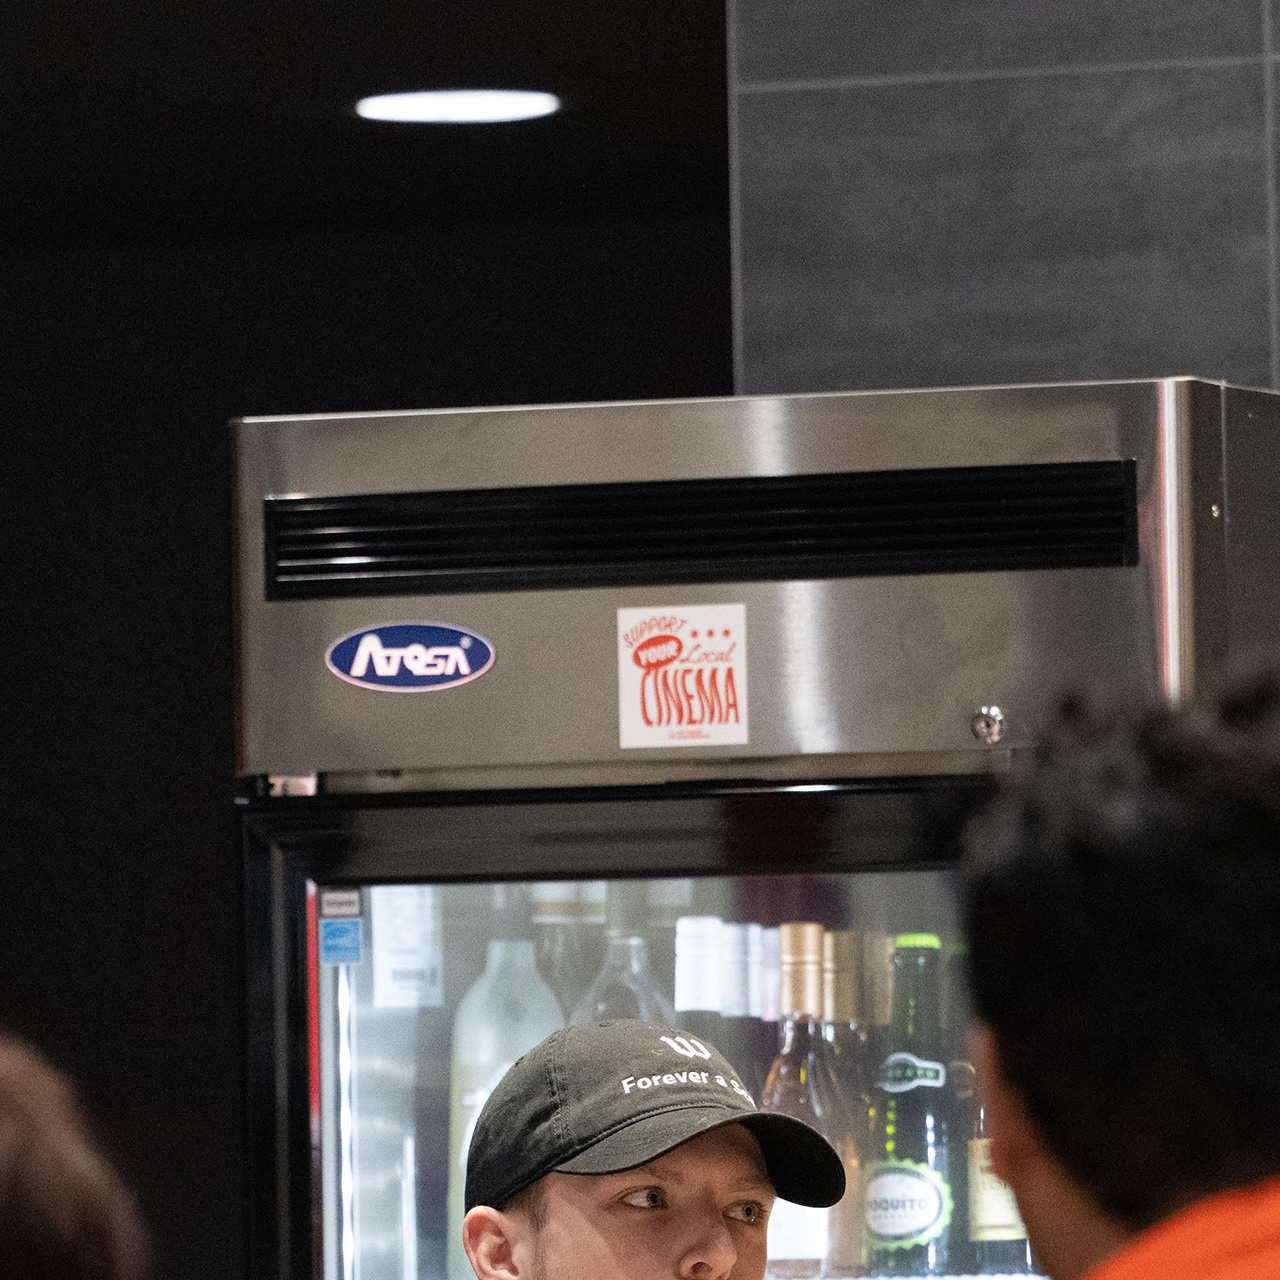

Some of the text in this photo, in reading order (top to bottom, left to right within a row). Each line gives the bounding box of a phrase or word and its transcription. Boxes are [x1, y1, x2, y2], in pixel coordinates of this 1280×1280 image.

[624, 616, 687, 648] SUPPORT
[679, 642, 737, 663] Local
[640, 667, 740, 727] CINEMA
[622, 1071, 709, 1094] Forever
[715, 1075, 728, 1088] a
